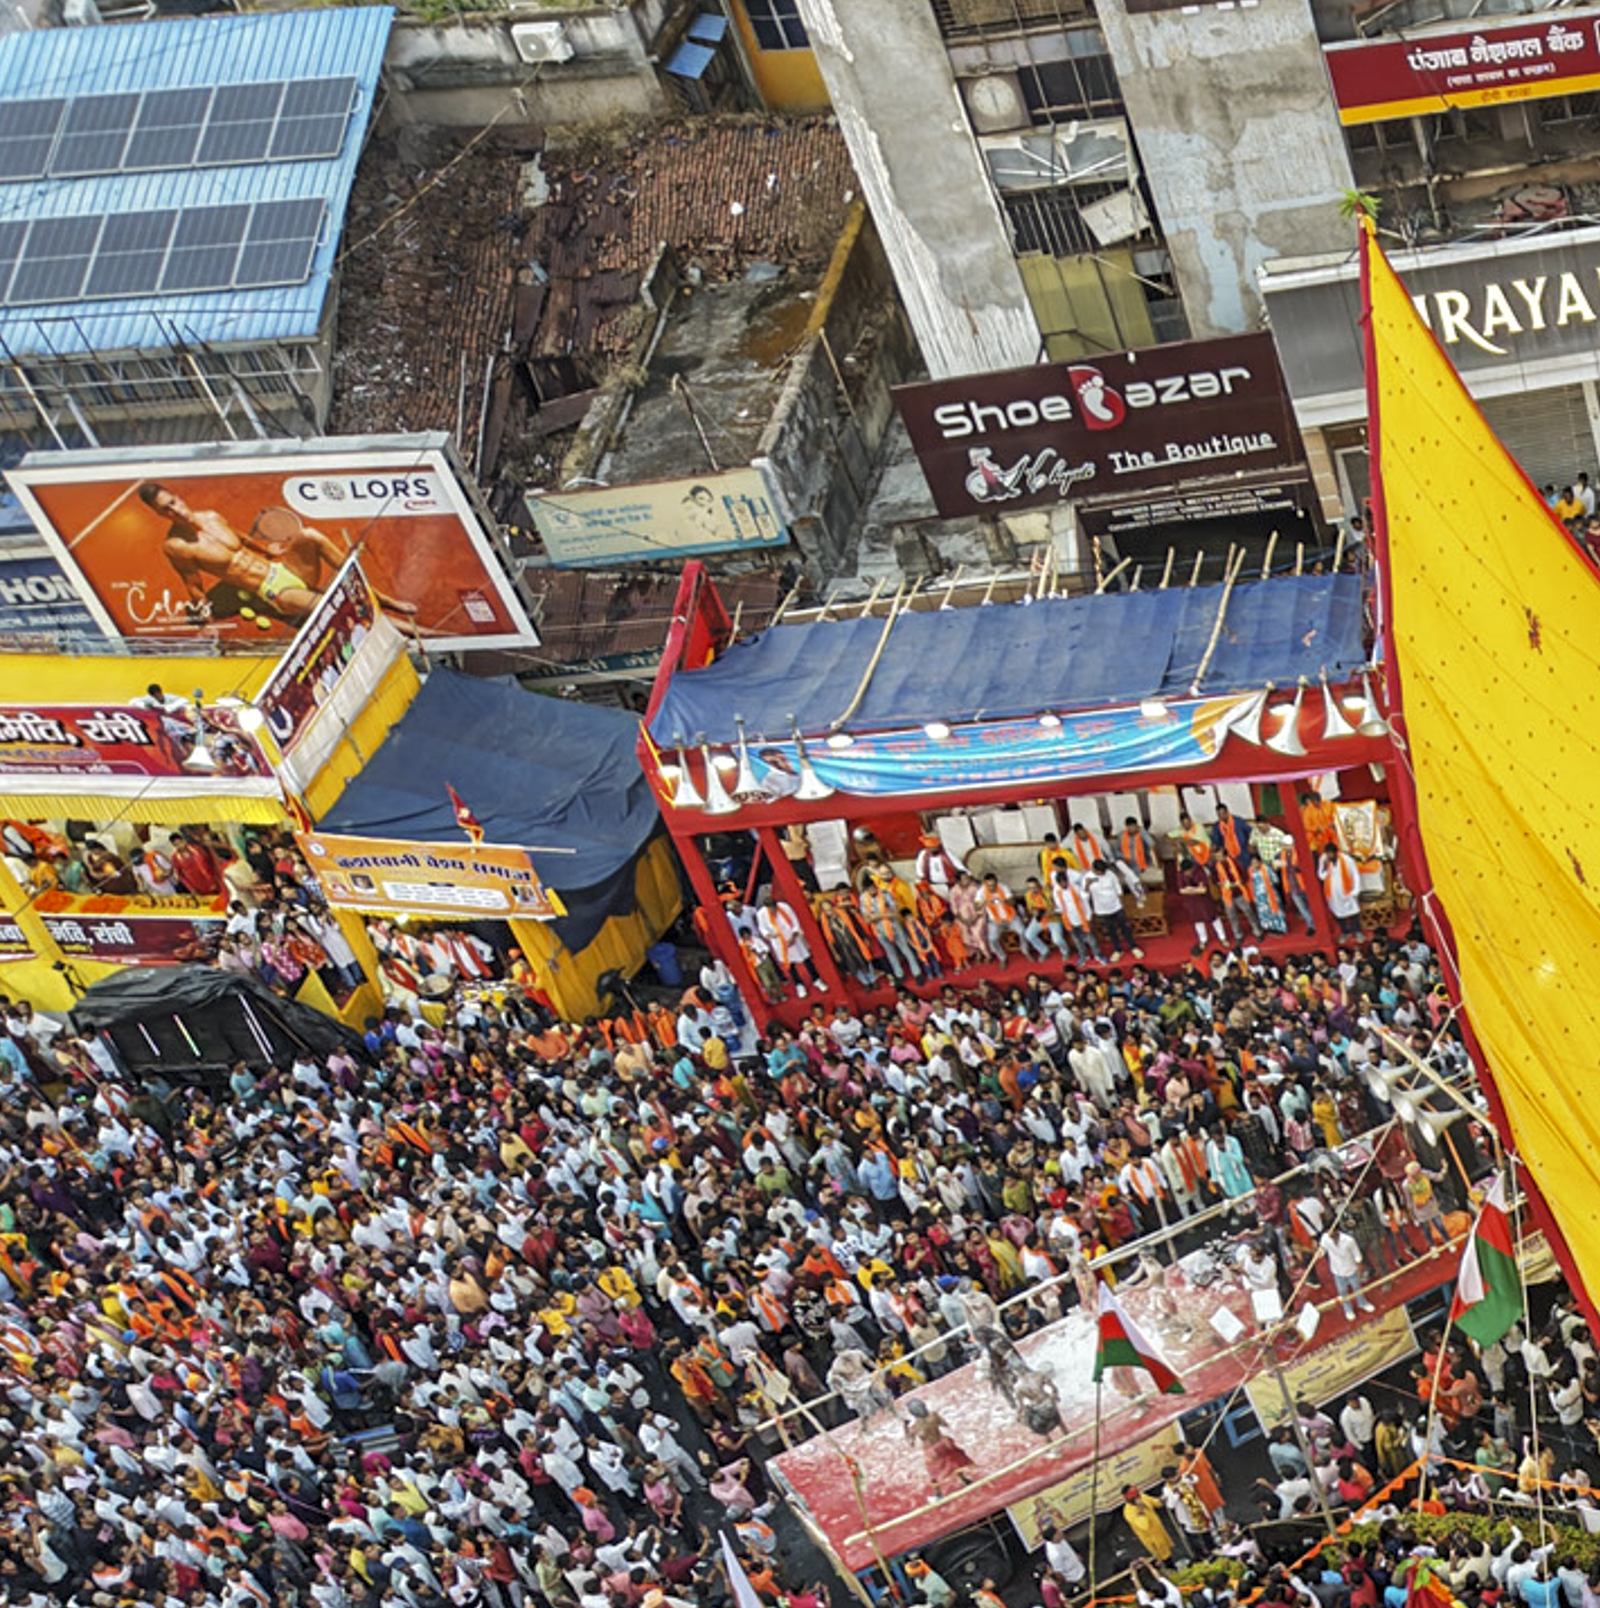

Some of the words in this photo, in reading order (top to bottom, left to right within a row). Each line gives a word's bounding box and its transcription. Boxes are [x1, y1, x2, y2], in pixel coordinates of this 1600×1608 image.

[1407, 46, 1469, 71] पंजाब
[1547, 25, 1585, 52] बैंक
[1108, 448, 1156, 473] The
[1164, 431, 1277, 464] Boutique
[75, 710, 150, 744] रांची
